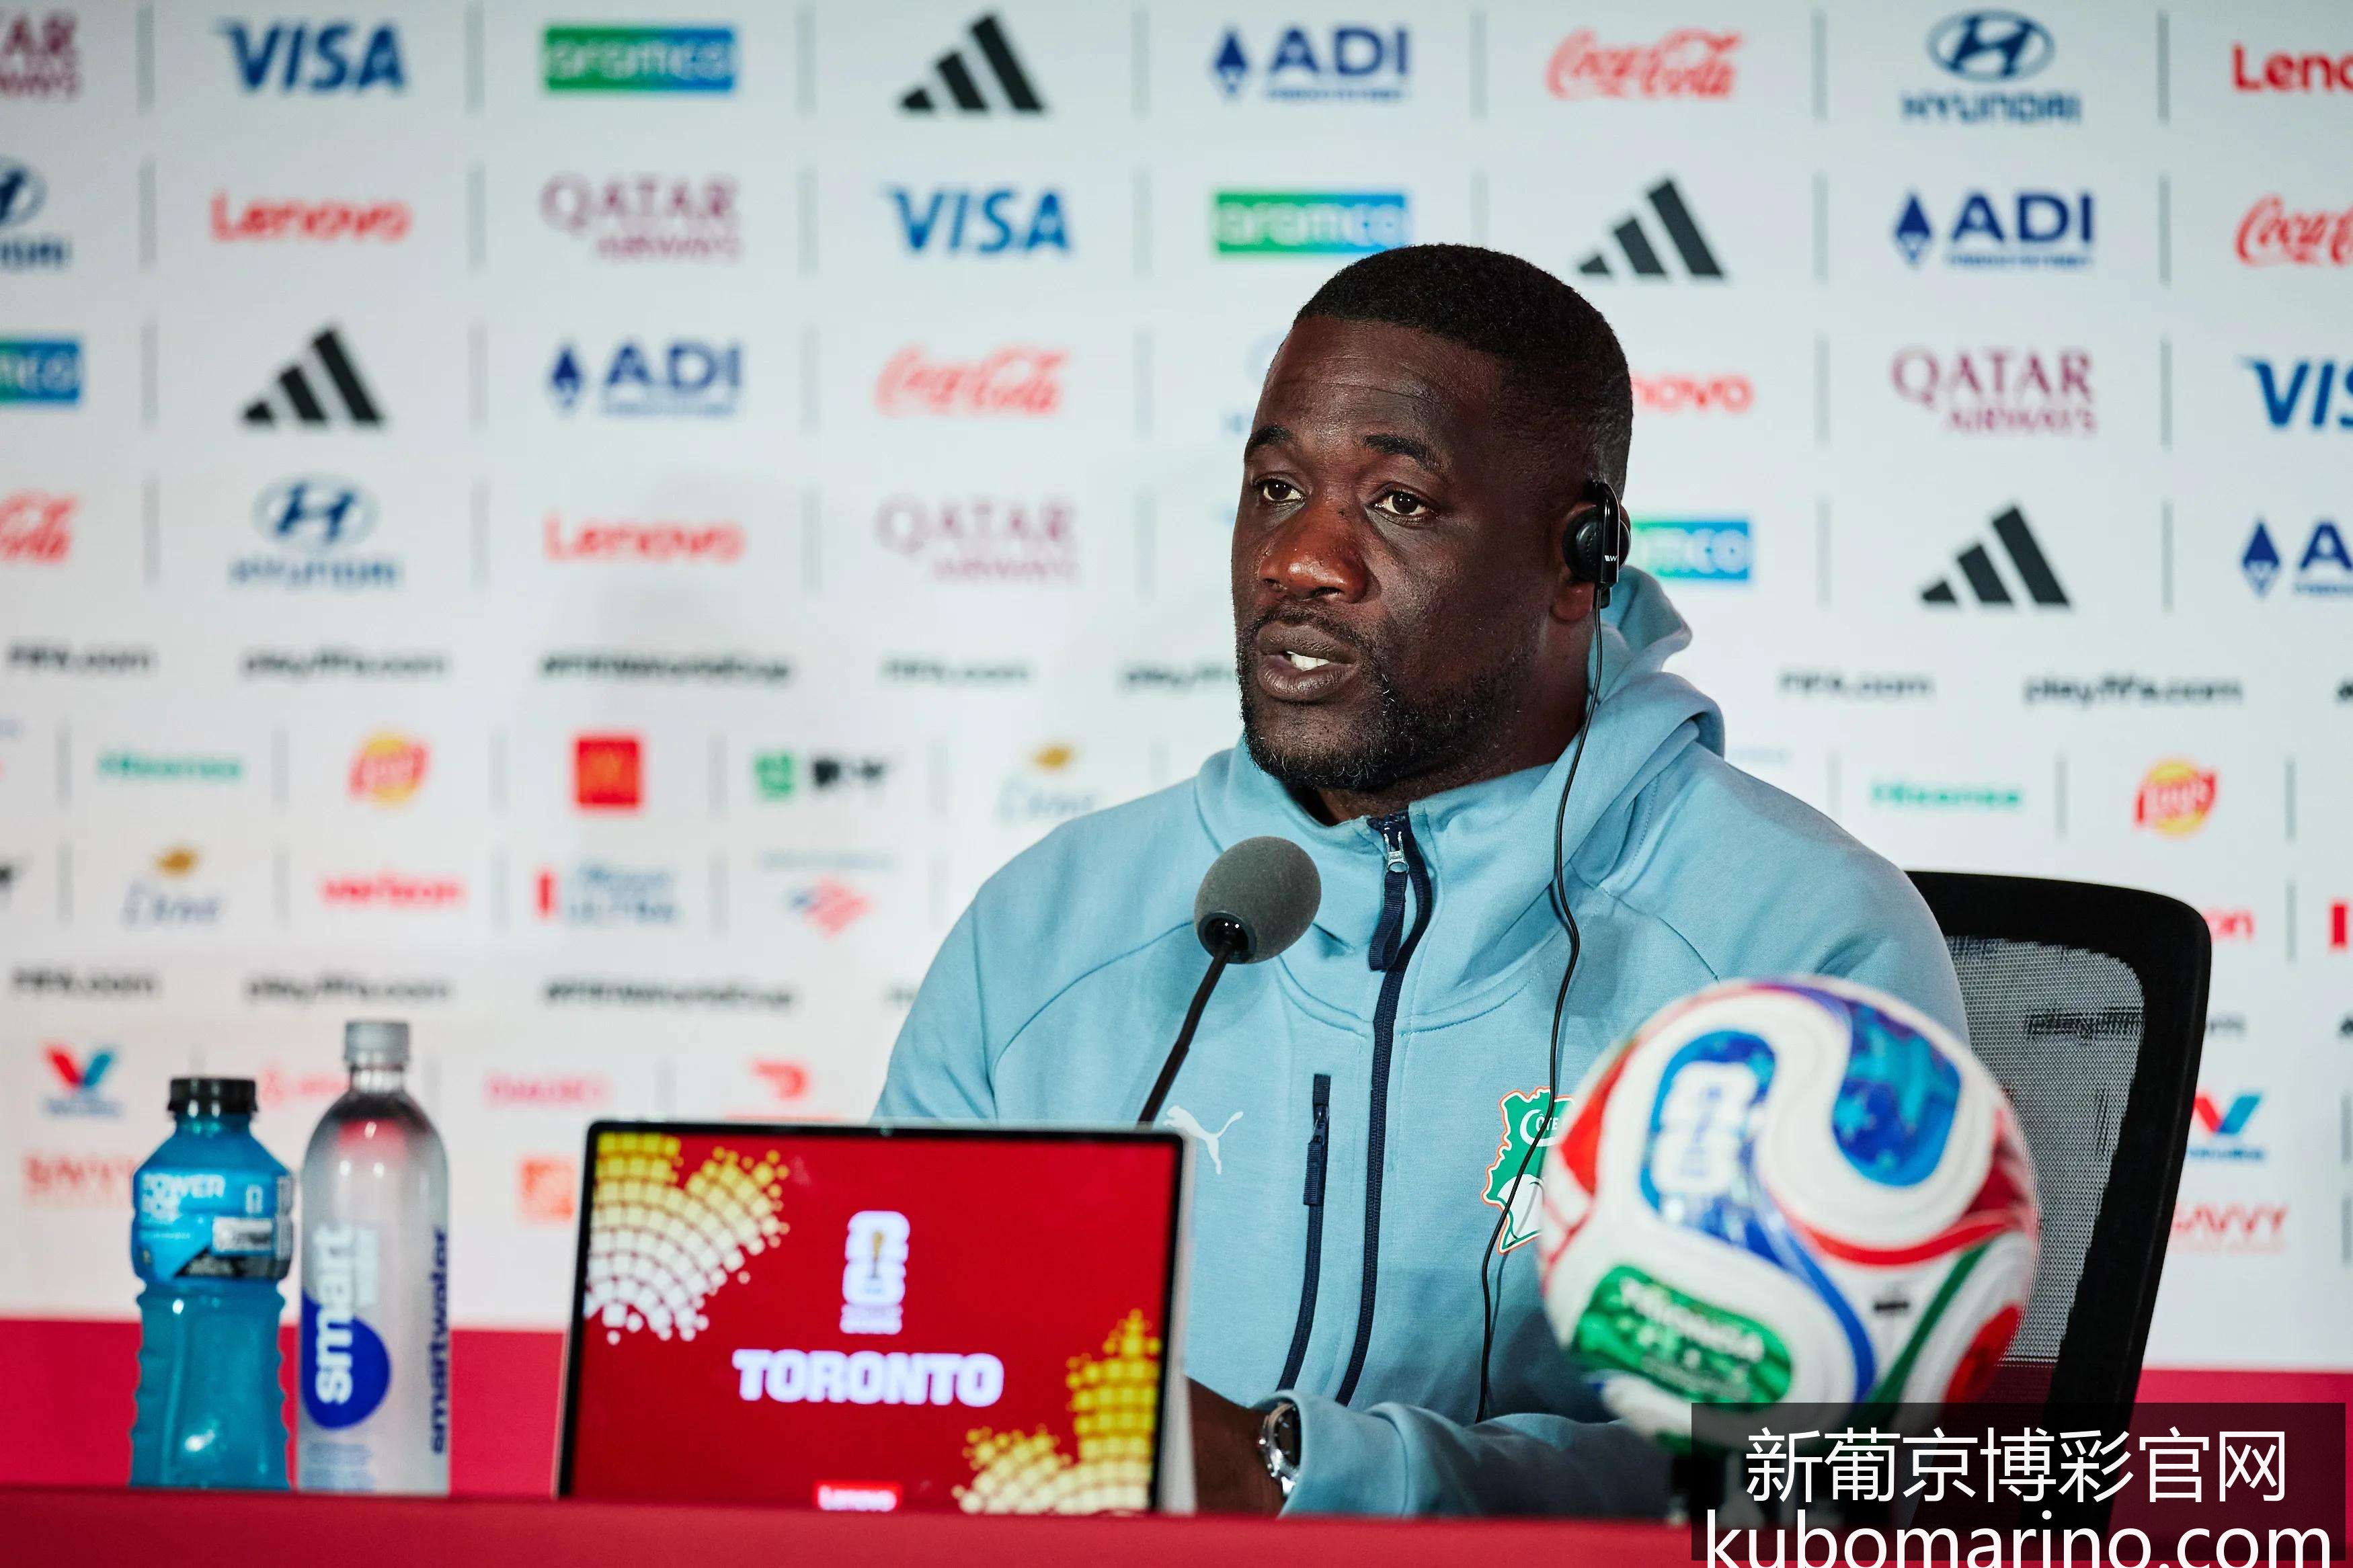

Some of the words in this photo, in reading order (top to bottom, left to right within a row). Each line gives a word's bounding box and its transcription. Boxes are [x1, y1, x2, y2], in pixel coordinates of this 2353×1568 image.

[221, 21, 406, 93] VISA
[1269, 26, 1409, 77] ADI
[1546, 28, 1743, 99] Coca-Cola
[210, 192, 410, 241] Lenovo
[887, 188, 1072, 255] VISA
[1950, 192, 2093, 243] ADI
[604, 341, 741, 391] ADI
[875, 346, 1068, 417] Coca-Cola
[1634, 375, 1755, 413] novo
[1890, 348, 2092, 409] QATAR
[546, 518, 744, 563] Lenovo
[316, 1225, 352, 1405] smart
[732, 1349, 1004, 1407] TORONTO
